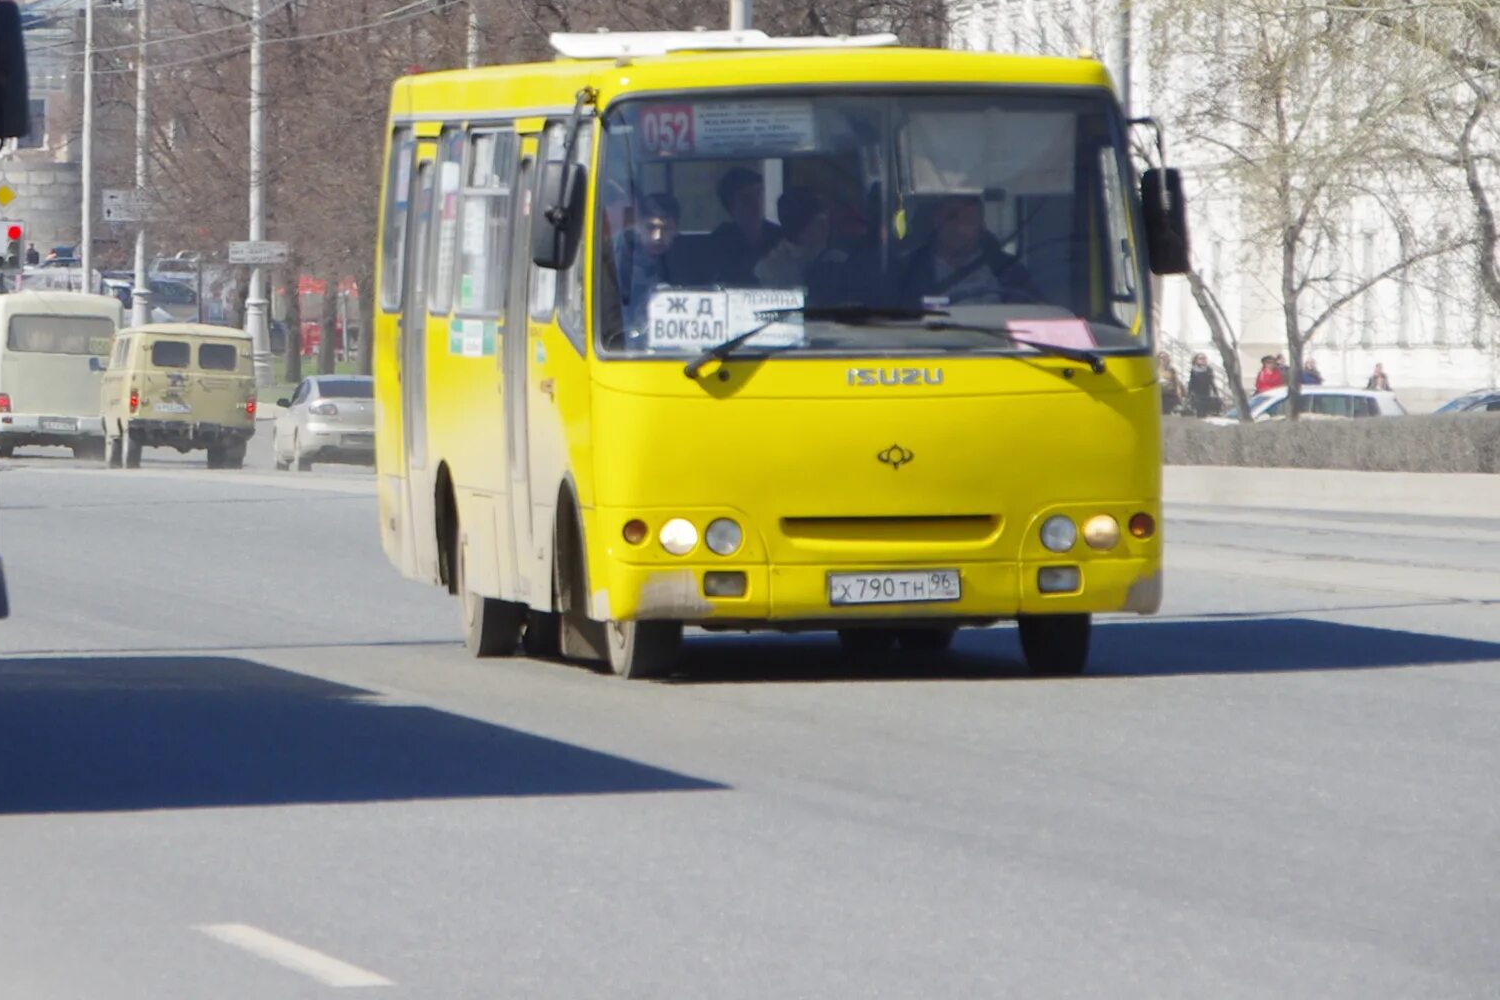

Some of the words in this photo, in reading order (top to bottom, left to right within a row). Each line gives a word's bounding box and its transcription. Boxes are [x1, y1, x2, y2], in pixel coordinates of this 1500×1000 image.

[644, 111, 690, 151] 052
[654, 320, 723, 340] ВОКЗАЛ
[847, 368, 944, 386] ISUZU
[930, 573, 951, 591] 96
